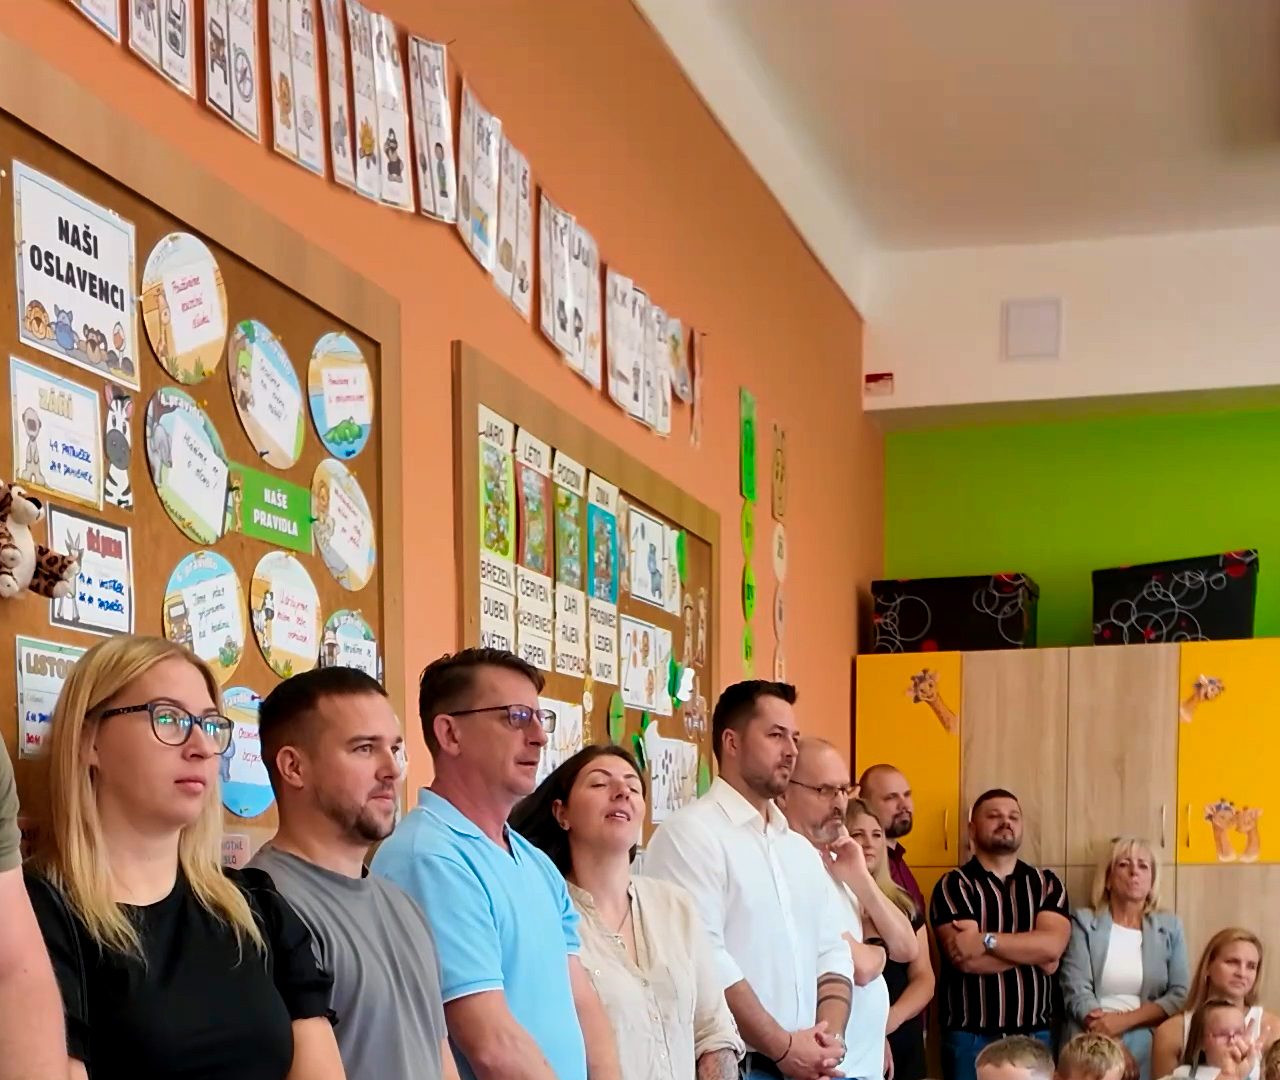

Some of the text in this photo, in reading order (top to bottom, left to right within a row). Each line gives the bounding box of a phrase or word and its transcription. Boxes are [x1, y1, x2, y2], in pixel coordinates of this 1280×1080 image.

[57, 216, 99, 260] NAŠI
[30, 244, 125, 313] OSLAVENCI
[485, 420, 504, 447] JARO
[524, 442, 541, 469] LÉTO
[558, 462, 581, 491] PODZIM
[263, 487, 289, 510] NAŠE
[596, 486, 609, 505] ZIMA
[253, 508, 299, 537] PRAVIDLA
[481, 559, 511, 589] BŘEZEN
[519, 574, 549, 603] ČERVEN
[484, 596, 508, 622] DUBEN
[519, 611, 551, 634] ČERVENEC
[524, 643, 546, 666] SRPEN
[595, 634, 612, 654] LEDEN
[556, 652, 585, 674] LISTOPAD
